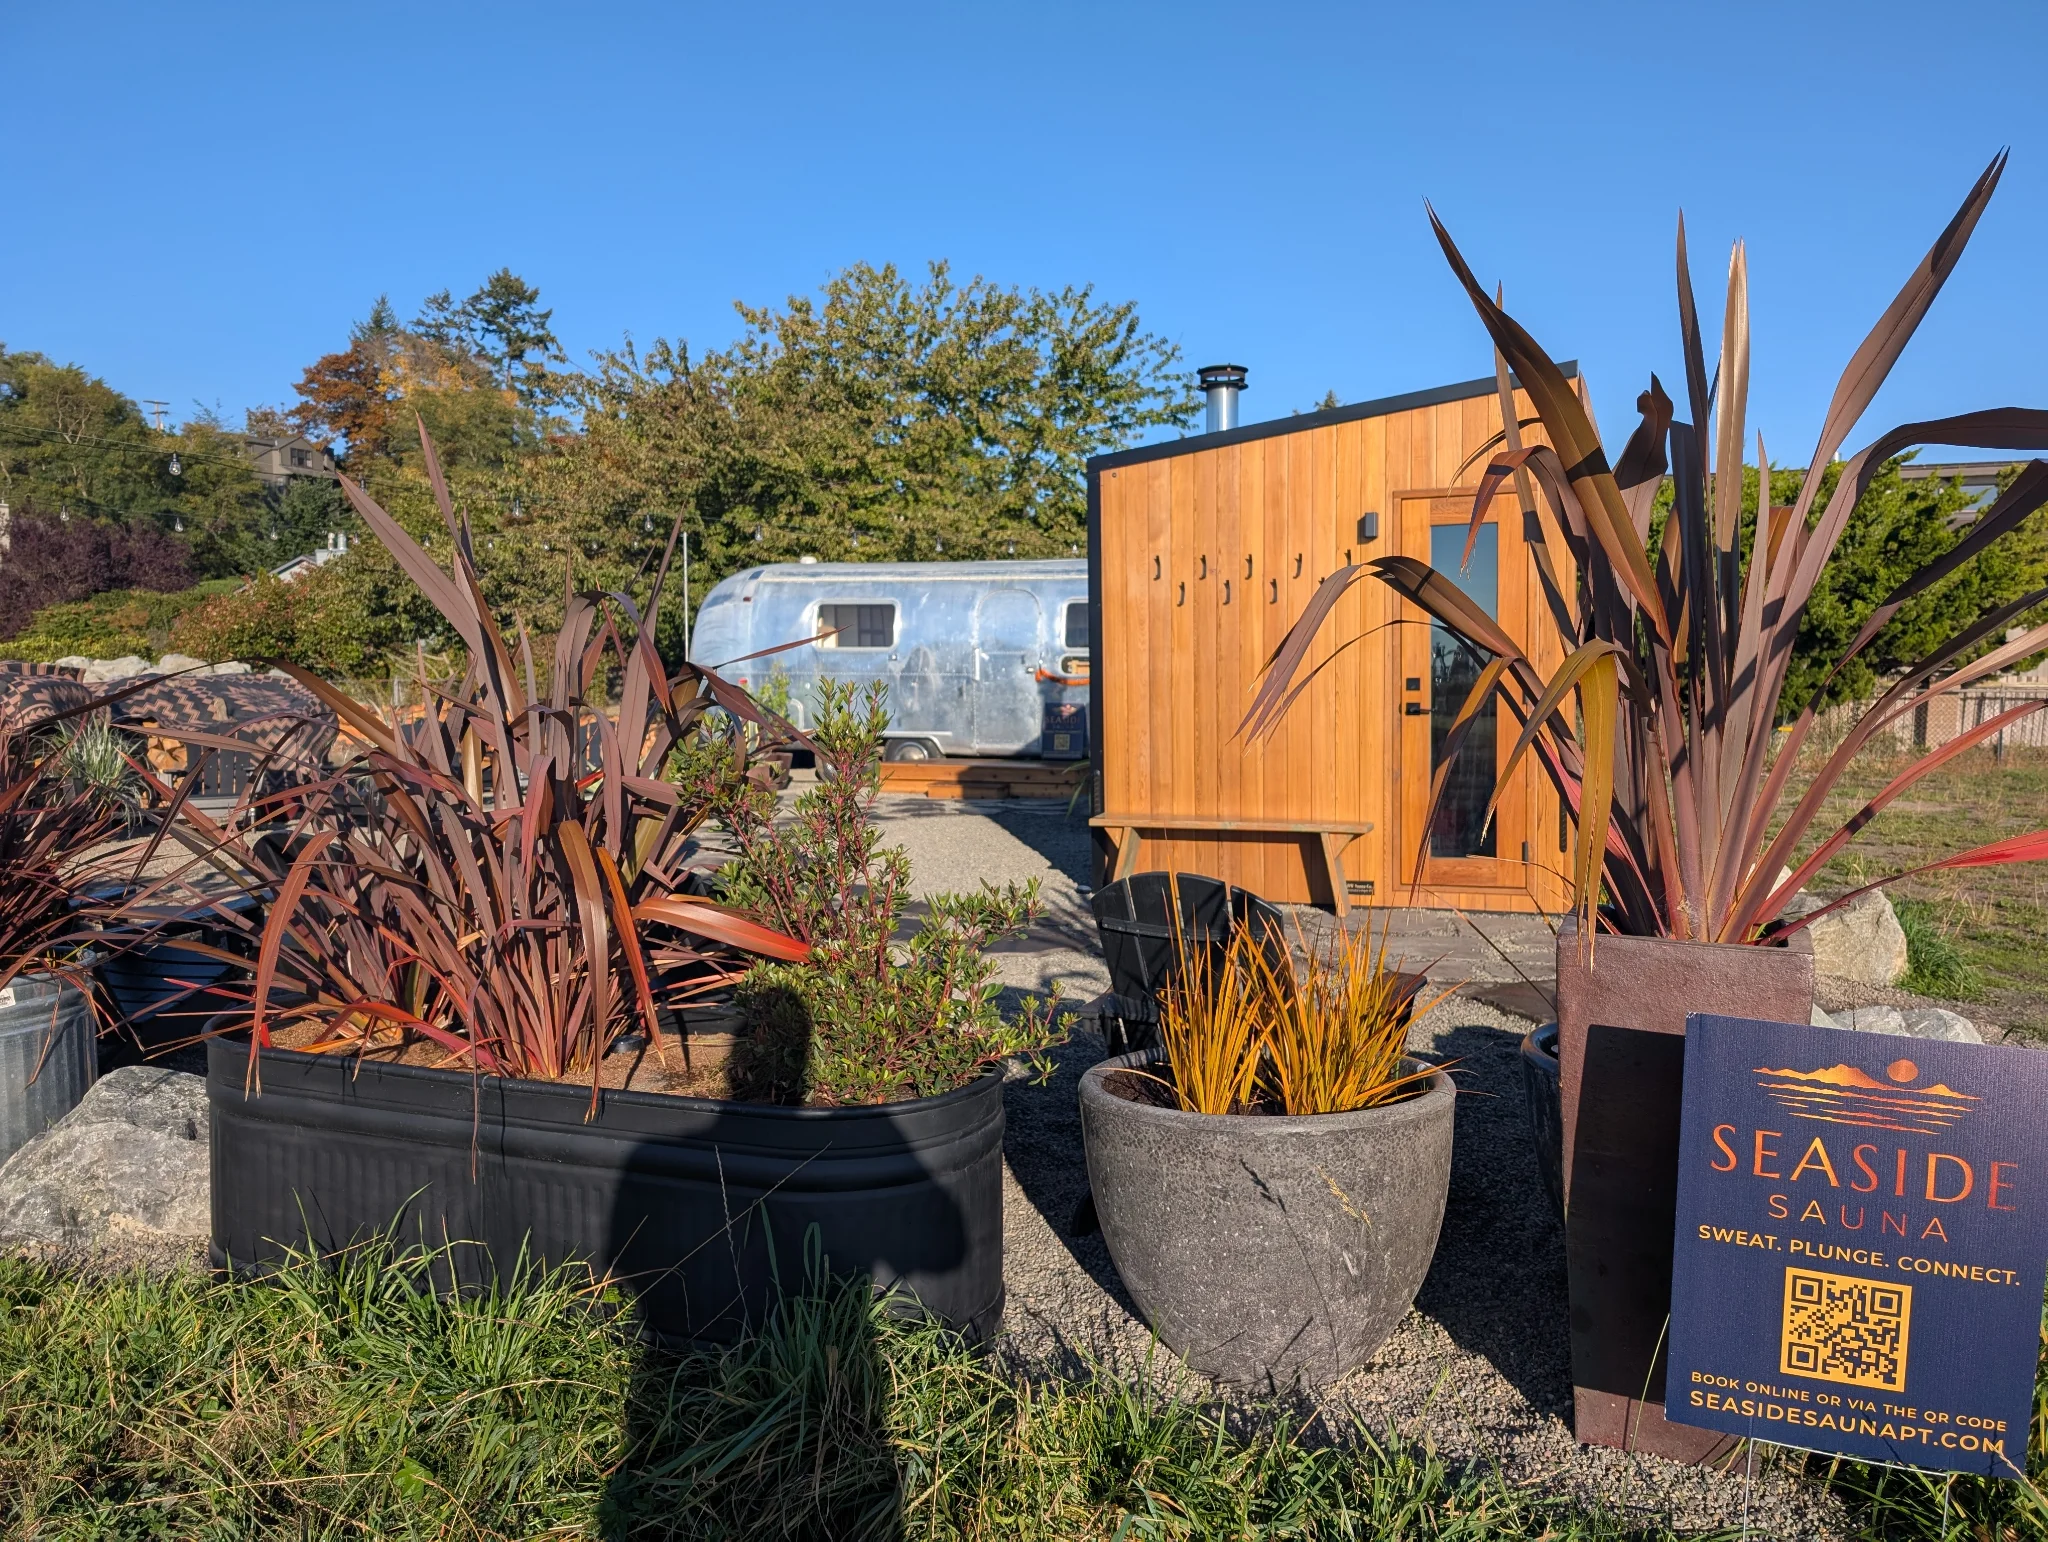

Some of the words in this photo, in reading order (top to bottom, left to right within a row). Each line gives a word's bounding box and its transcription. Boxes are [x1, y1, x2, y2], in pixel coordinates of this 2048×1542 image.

[1710, 1123, 2019, 1212] SEASIDE
[1768, 1194, 1949, 1244] SAUNA
[1699, 1225, 1782, 1252] SWEAT.
[1790, 1240, 1890, 1268] PLUNGE.
[1898, 1256, 2021, 1287] CONNECT.
[1690, 1390, 2005, 1454] SEASIDESAUNAPT.COM
[1691, 1371, 1740, 1391] BOOK
[1745, 1381, 1810, 1402] ONLINE
[1816, 1393, 1841, 1407] OR
[1847, 1398, 1877, 1414] VIA
[1883, 1404, 1918, 1419] THE
[1924, 1410, 1949, 1425] QR
[1955, 1415, 2008, 1433] CODE
